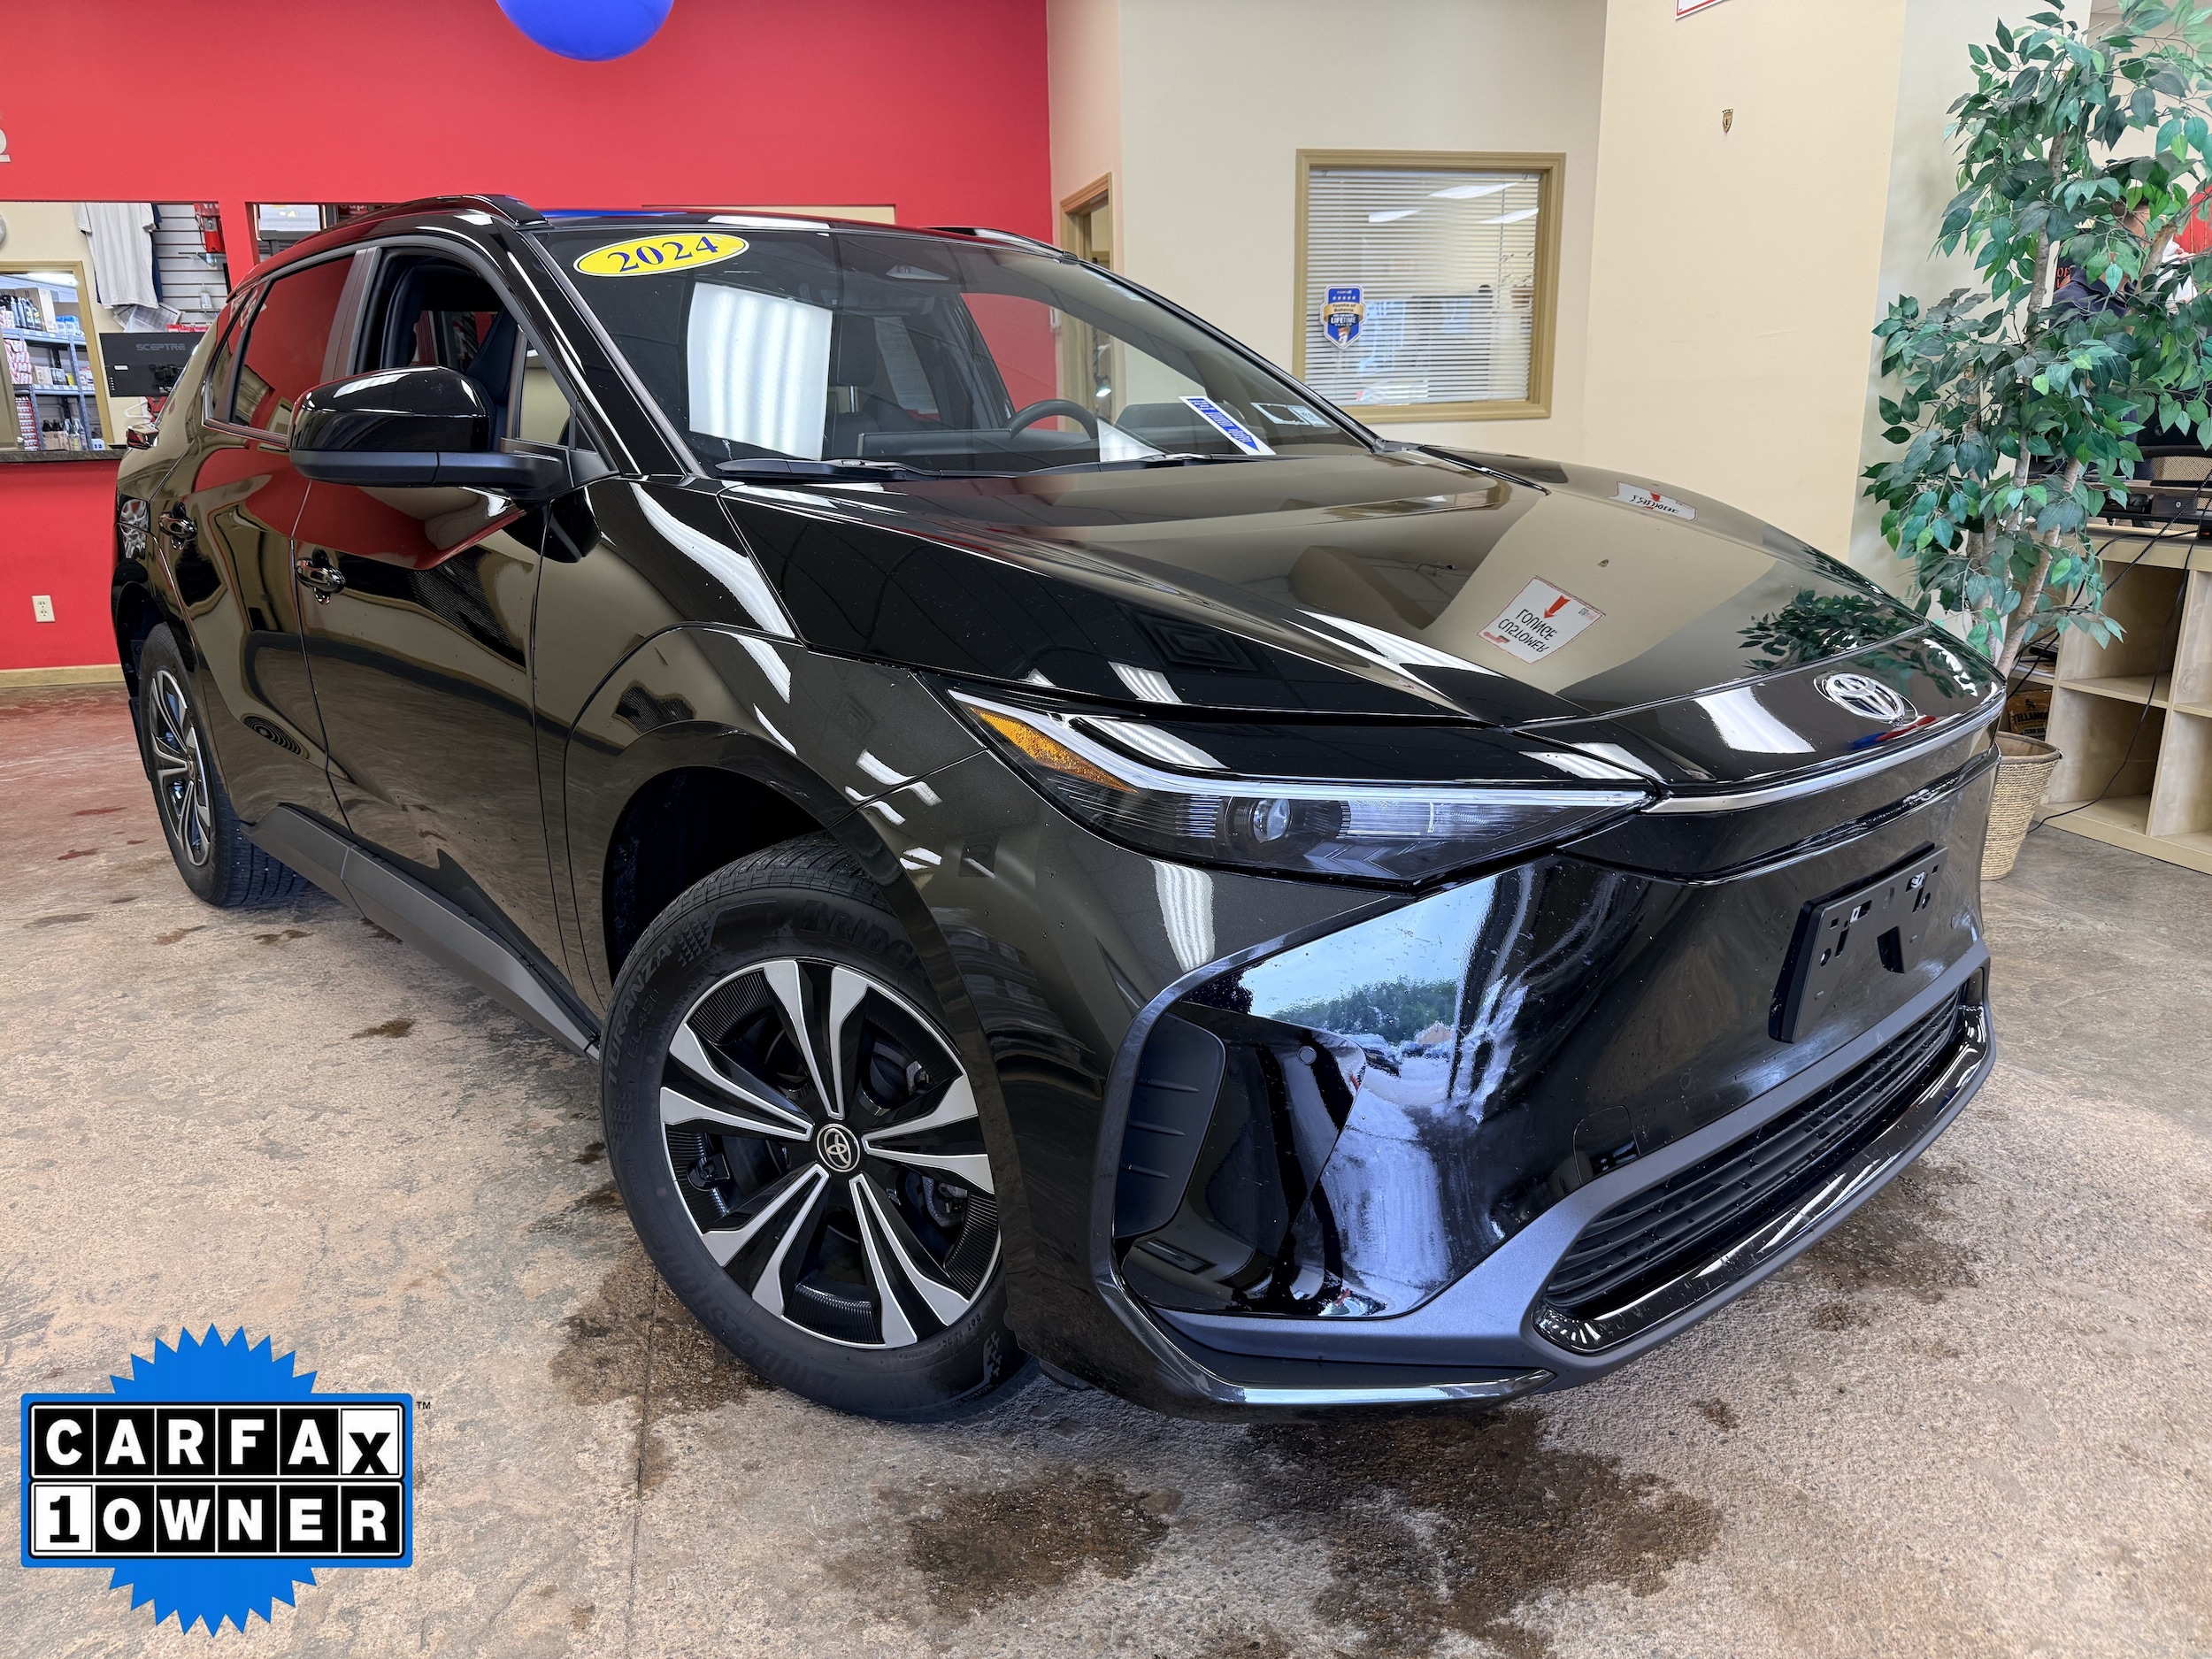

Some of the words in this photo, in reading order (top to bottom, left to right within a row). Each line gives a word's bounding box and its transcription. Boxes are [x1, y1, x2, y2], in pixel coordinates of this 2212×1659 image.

[607, 235, 718, 273] 2024
[135, 342, 186, 351] SCEPTRE
[608, 942, 673, 1086] TURANZA
